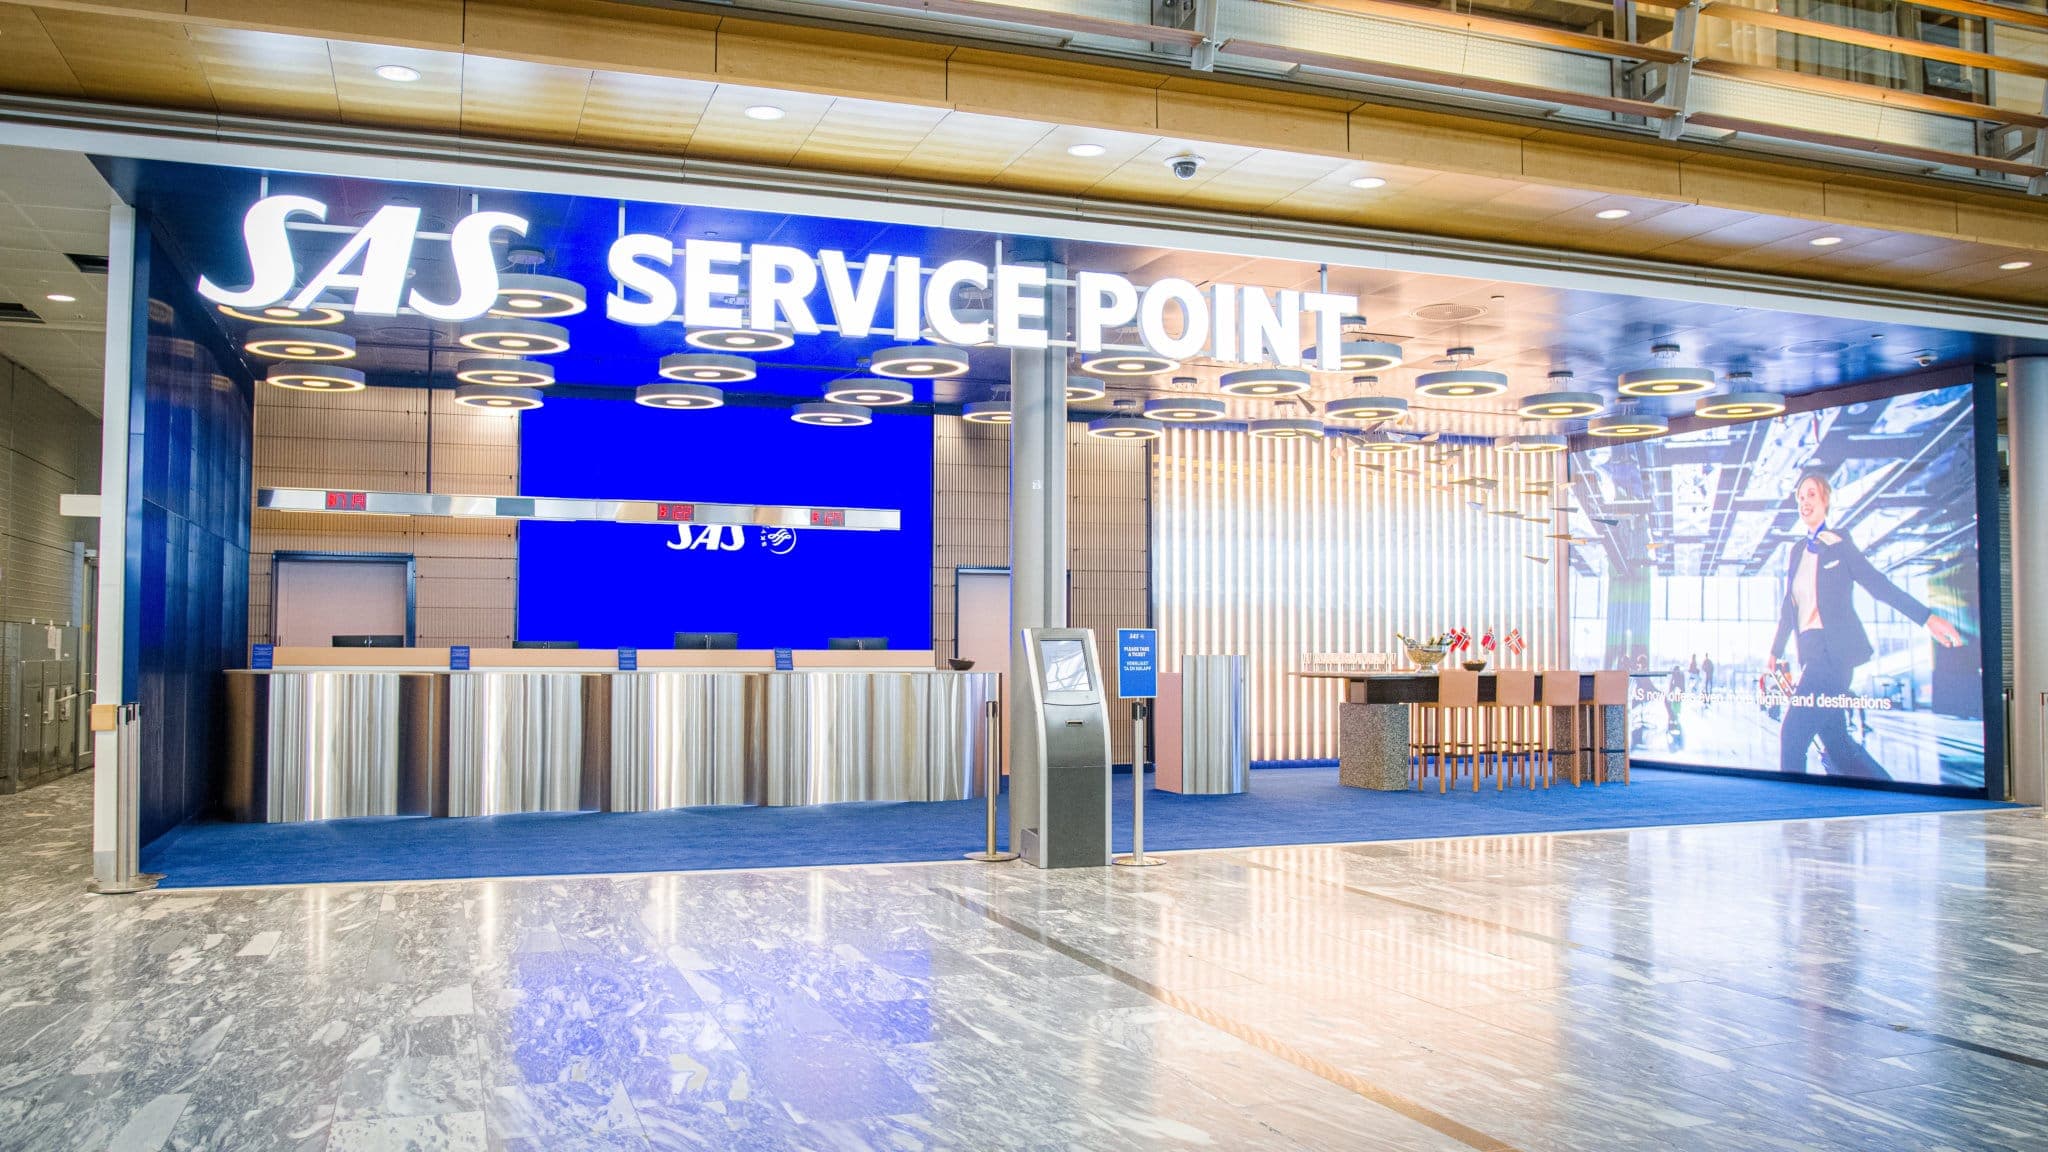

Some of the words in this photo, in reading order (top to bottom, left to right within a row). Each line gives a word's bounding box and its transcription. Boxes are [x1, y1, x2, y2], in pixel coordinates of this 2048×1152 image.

[197, 194, 529, 322] SAS
[606, 233, 1048, 350] SERVICE
[1075, 270, 1358, 371] POINT
[666, 524, 746, 551] SAS
[1632, 688, 1645, 701] AS
[1646, 690, 1666, 702] now
[1755, 690, 1789, 708] flights
[1791, 692, 1815, 708] and
[1816, 693, 1892, 710] destinations
